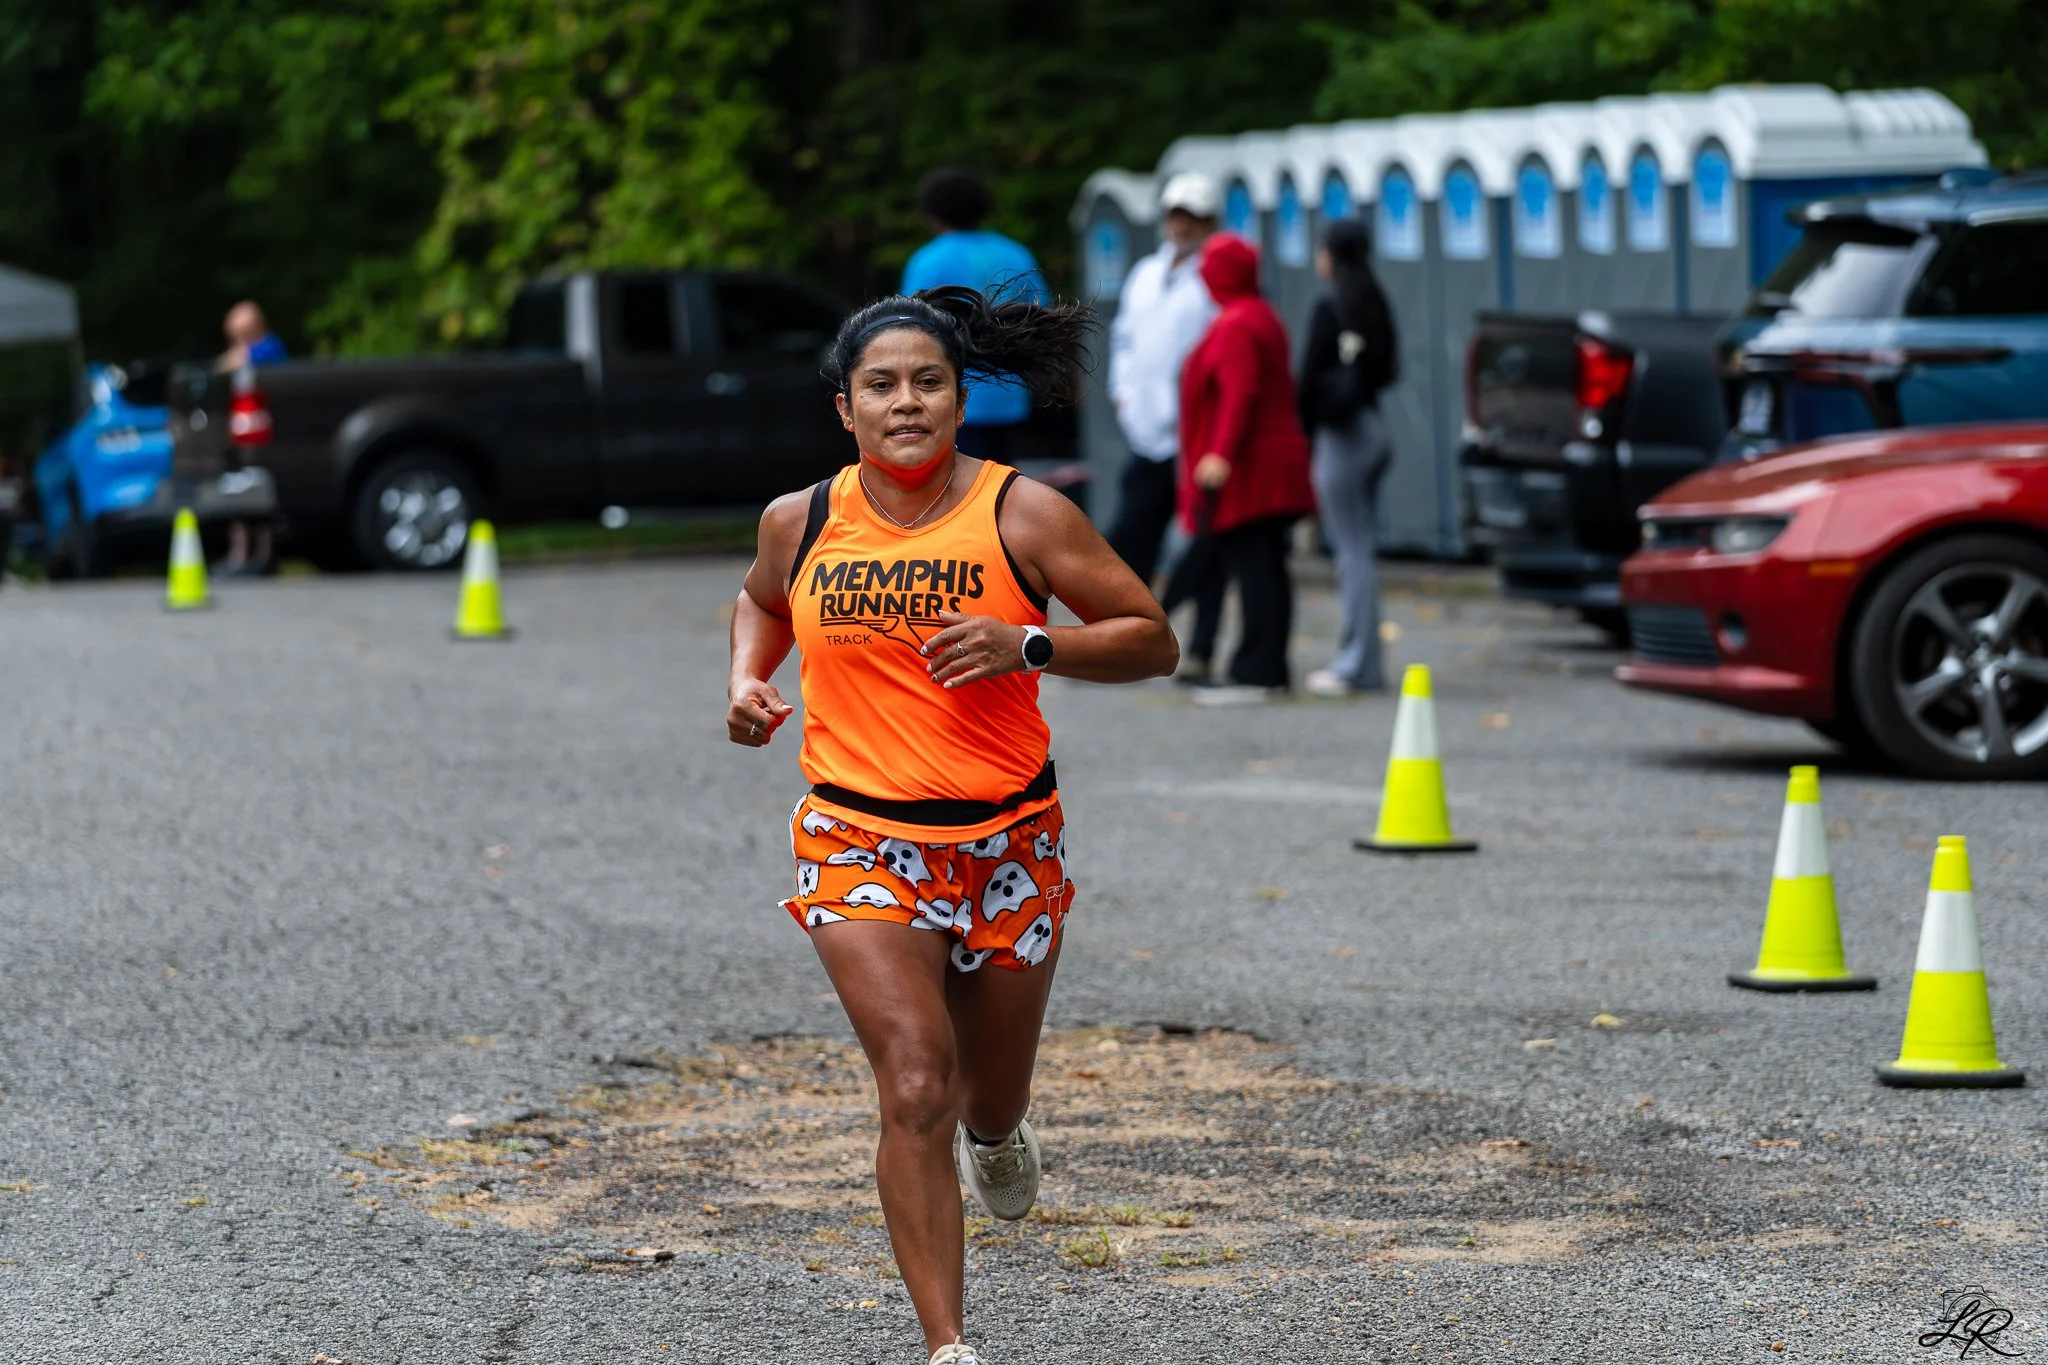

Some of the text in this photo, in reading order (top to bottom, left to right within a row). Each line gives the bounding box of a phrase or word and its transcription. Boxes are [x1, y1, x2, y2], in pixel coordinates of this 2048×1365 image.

[810, 559, 984, 599] MEMPHIS
[820, 592, 961, 618] RUNNERS
[825, 633, 873, 646] TRACK
